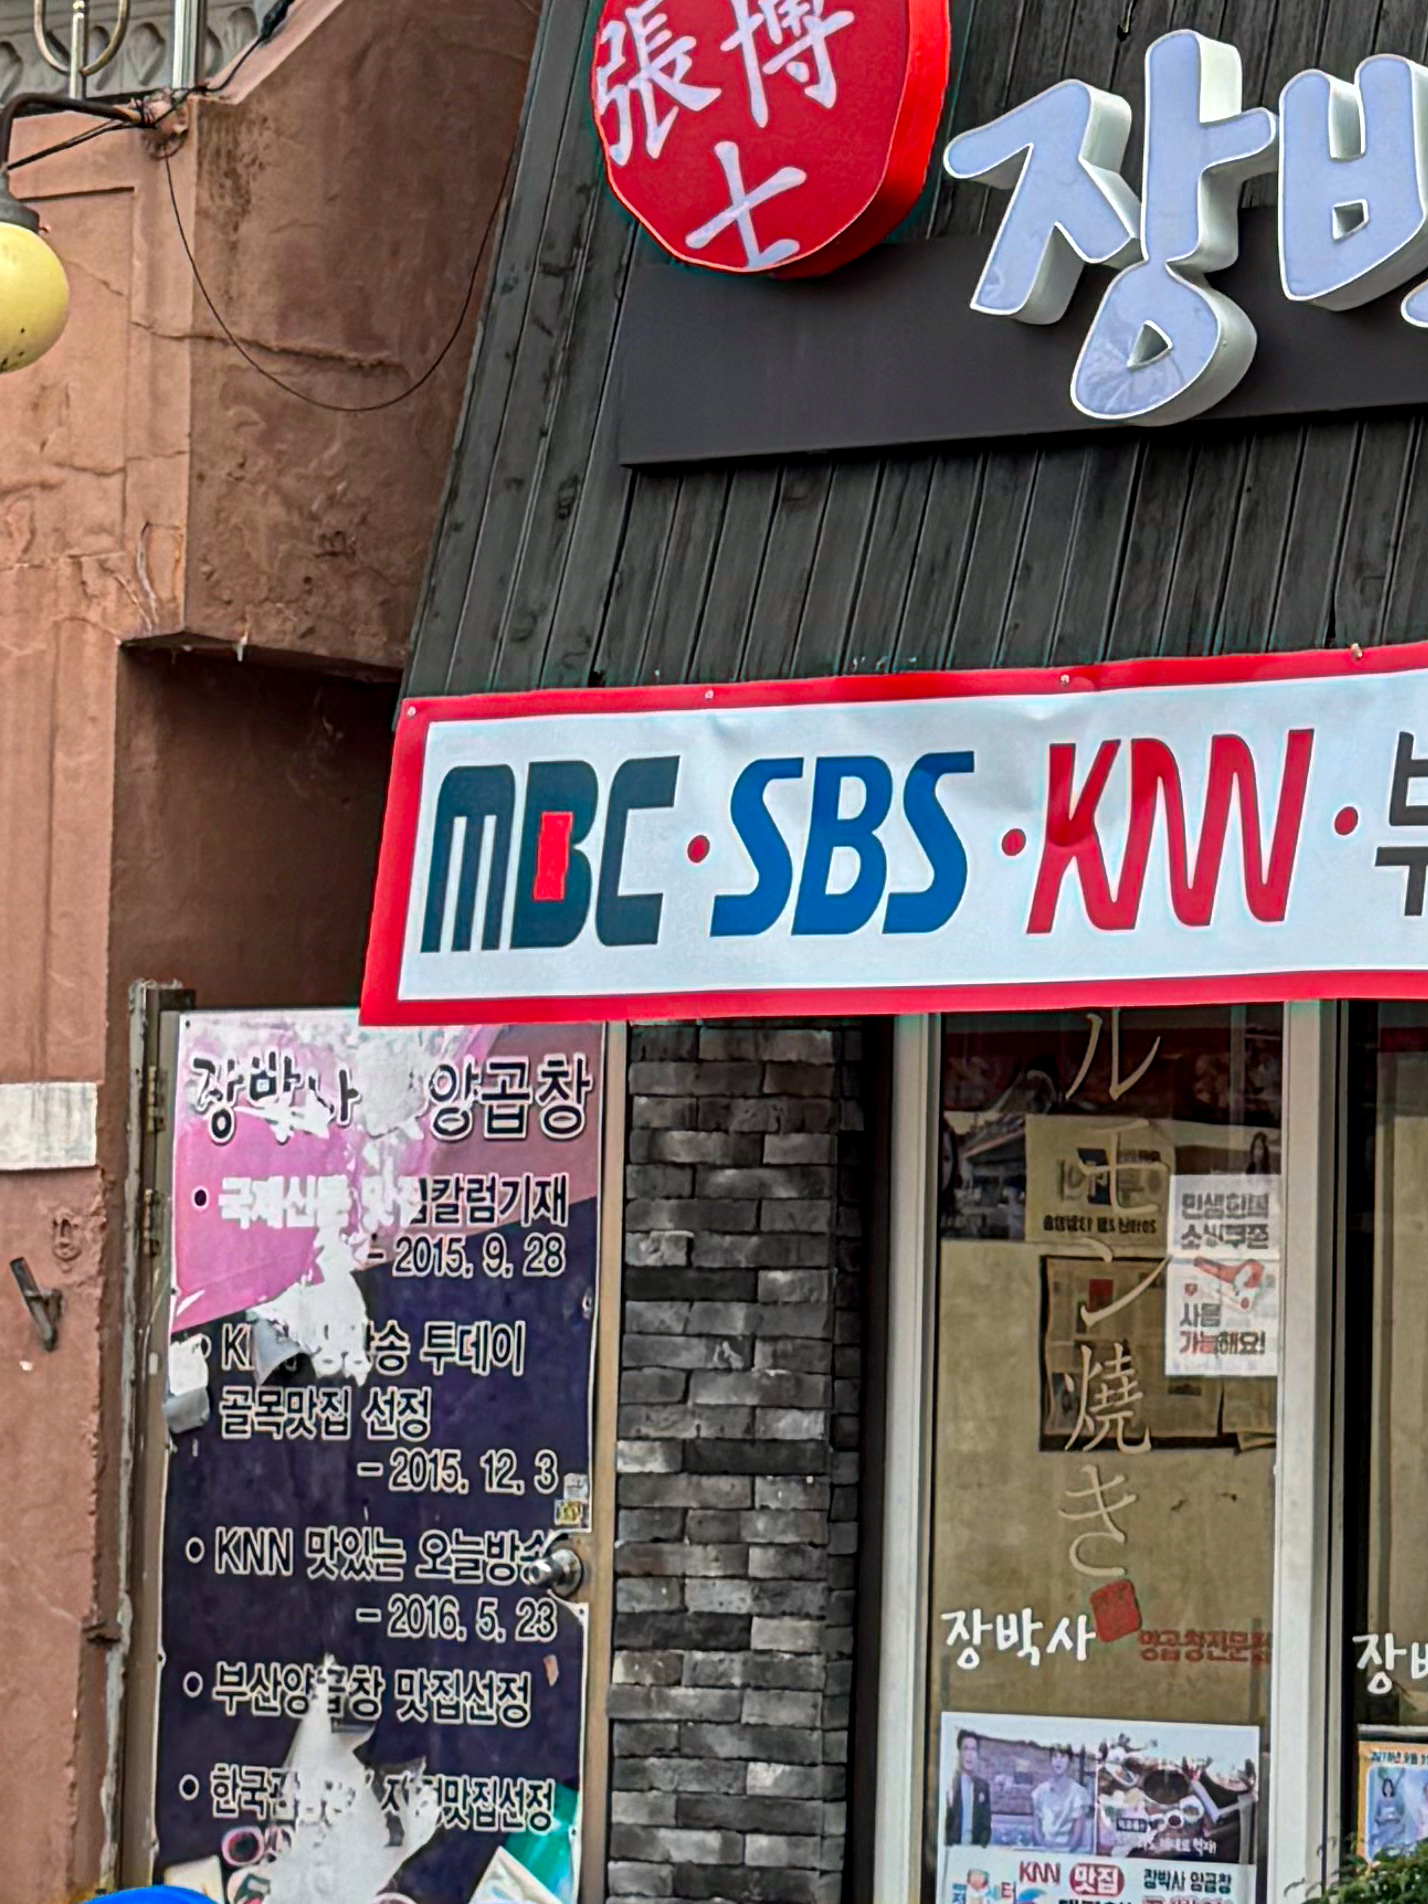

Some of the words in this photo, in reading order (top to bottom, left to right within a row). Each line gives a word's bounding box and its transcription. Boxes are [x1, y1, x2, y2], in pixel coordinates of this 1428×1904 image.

[429, 1052, 597, 1139] 양곱창
[524, 1232, 566, 1276] 28
[420, 1321, 526, 1377] 투데이
[219, 1385, 351, 1441] 골목맛집
[361, 1386, 432, 1442] 선정
[214, 1527, 293, 1576] KNN
[305, 1527, 405, 1582] 맛있는
[516, 1598, 558, 1642] 23
[941, 1607, 1096, 1669] 장박사
[395, 1668, 532, 1728] 맛집선정
[1019, 1861, 1061, 1883] KNN
